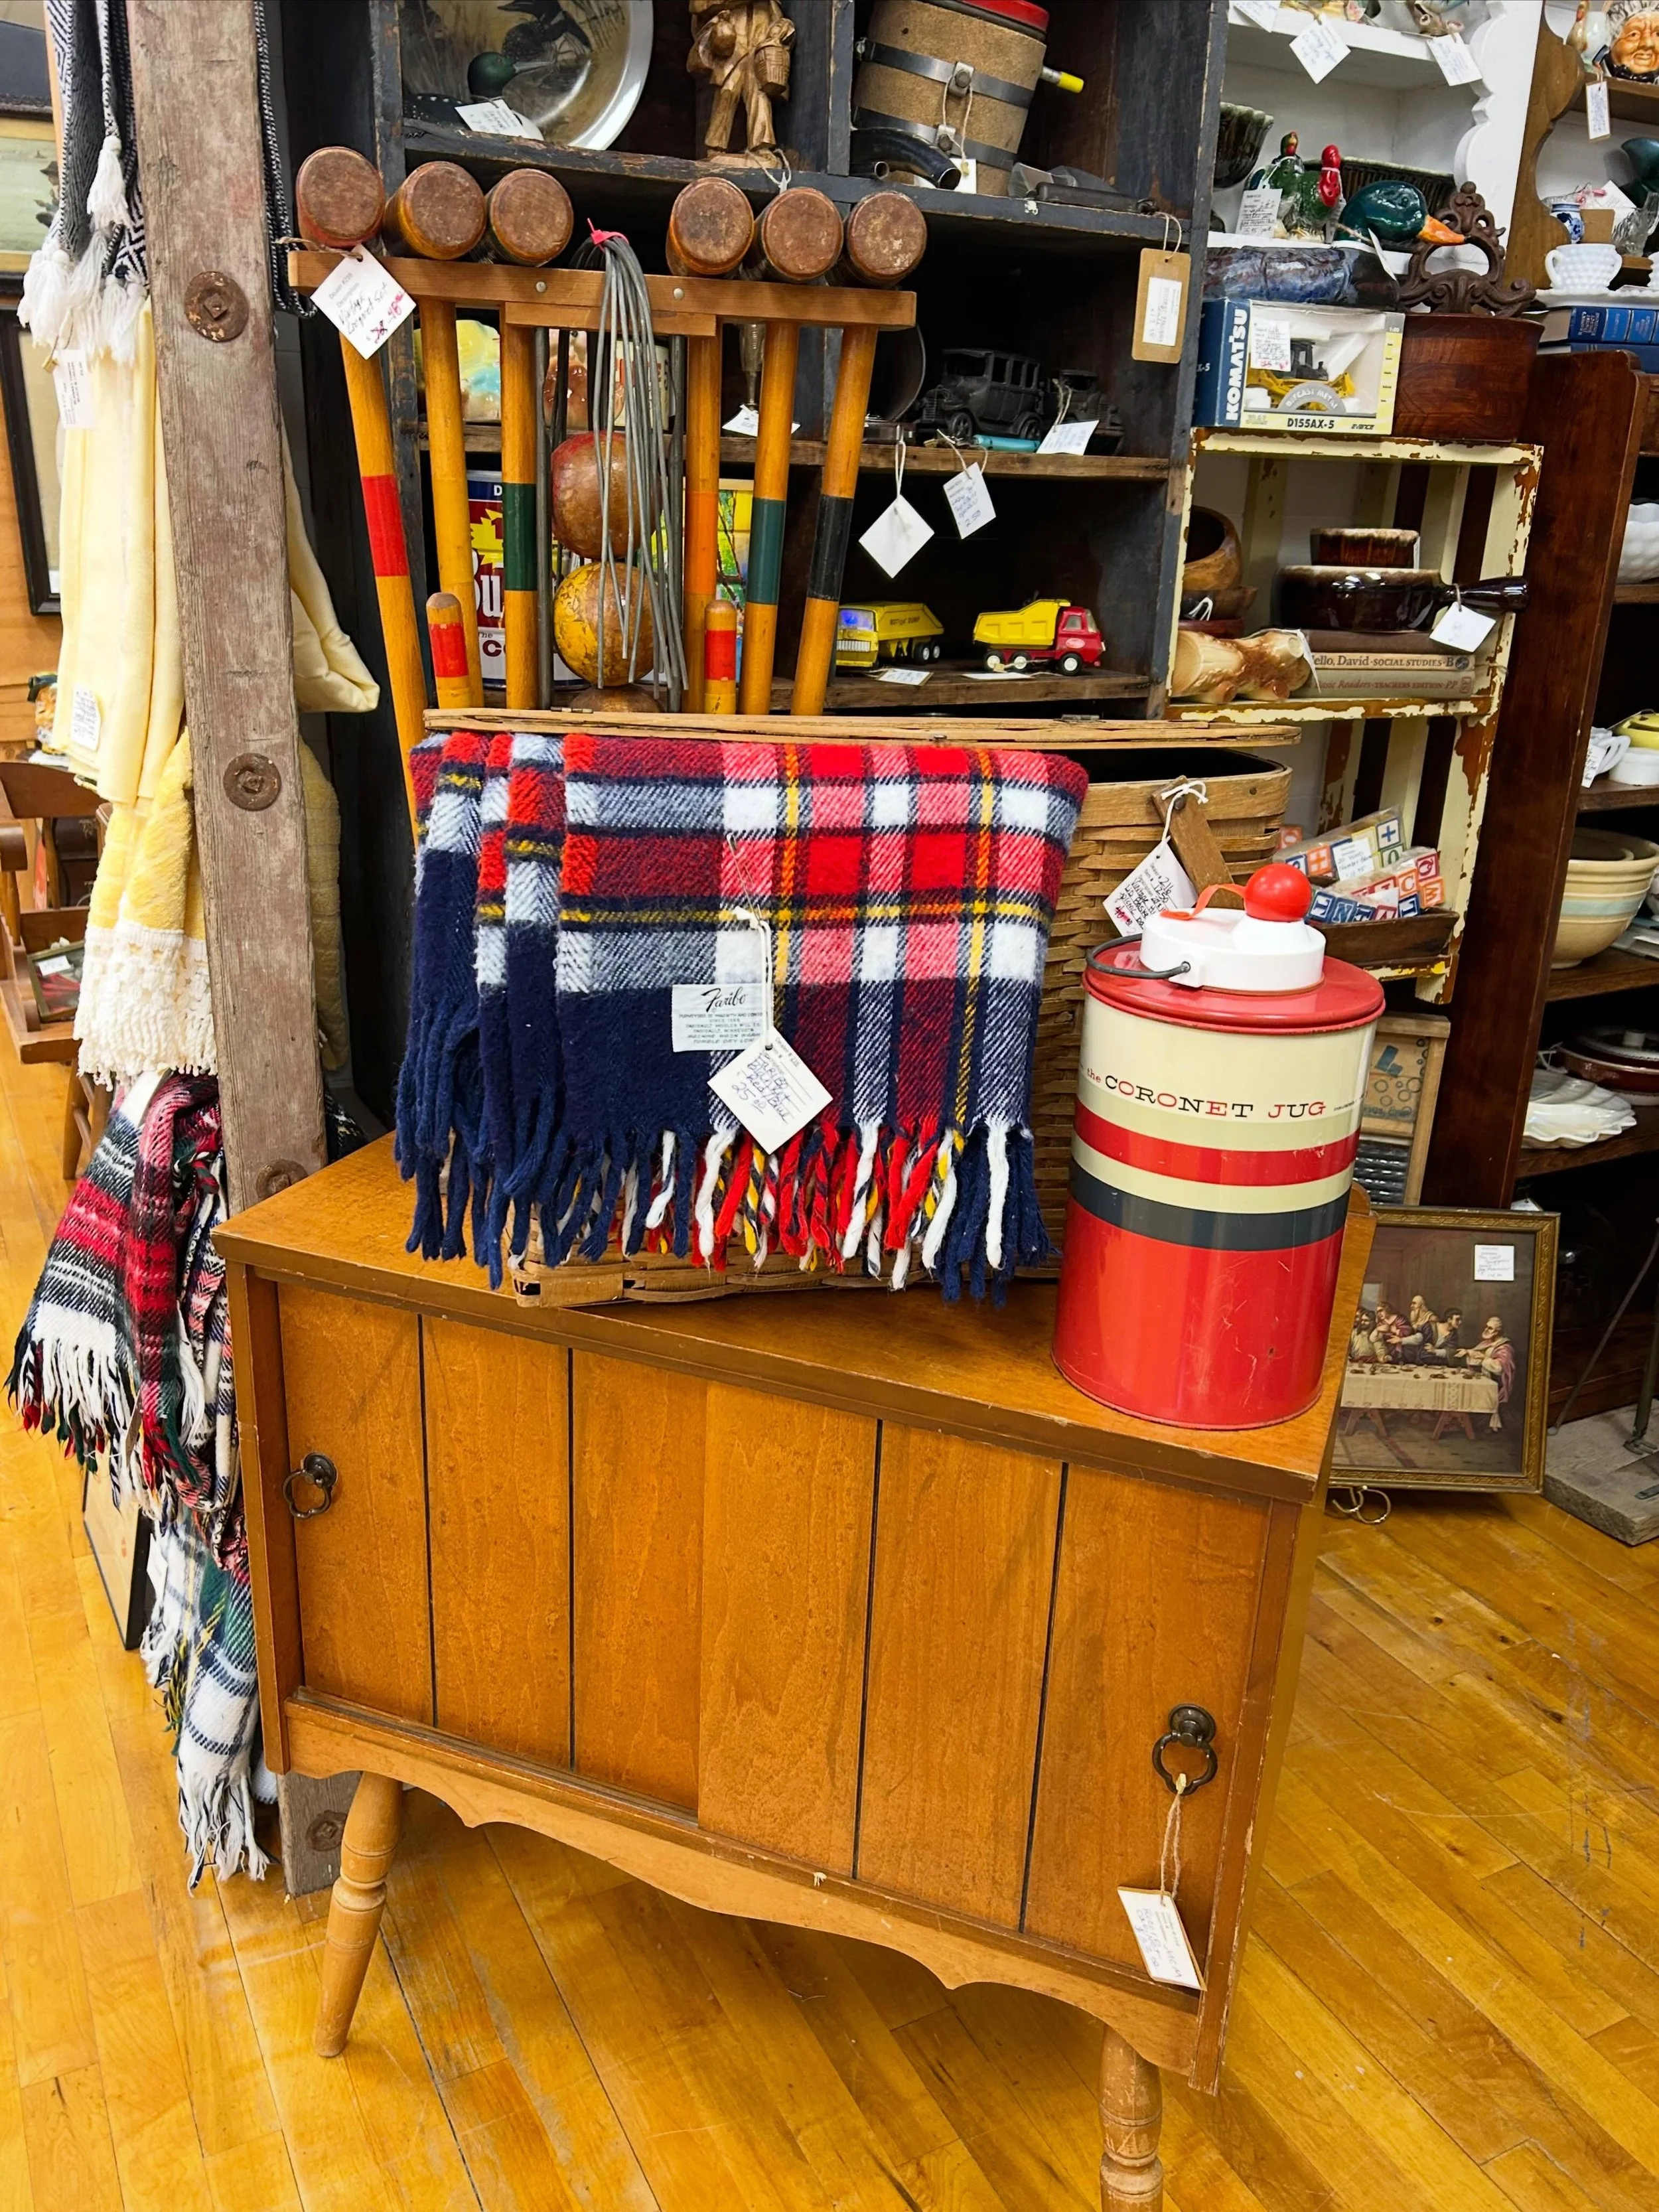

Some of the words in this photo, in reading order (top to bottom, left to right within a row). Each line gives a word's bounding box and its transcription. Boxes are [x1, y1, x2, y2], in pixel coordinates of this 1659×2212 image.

[1226, 309, 1249, 421] KOMATSU
[1286, 388, 1315, 407] DIECAST
[1287, 417, 1334, 429] D155AX-5
[1312, 655, 1335, 666] ello,
[1336, 655, 1369, 666] David
[1159, 876, 1174, 895] 216
[1401, 875, 1415, 892] C
[1153, 884, 1169, 903] 1250
[701, 986, 748, 1012] Faribo
[1086, 1067, 1102, 1083] the
[1105, 1075, 1254, 1118] CORONET
[1268, 1101, 1326, 1118] JUG
